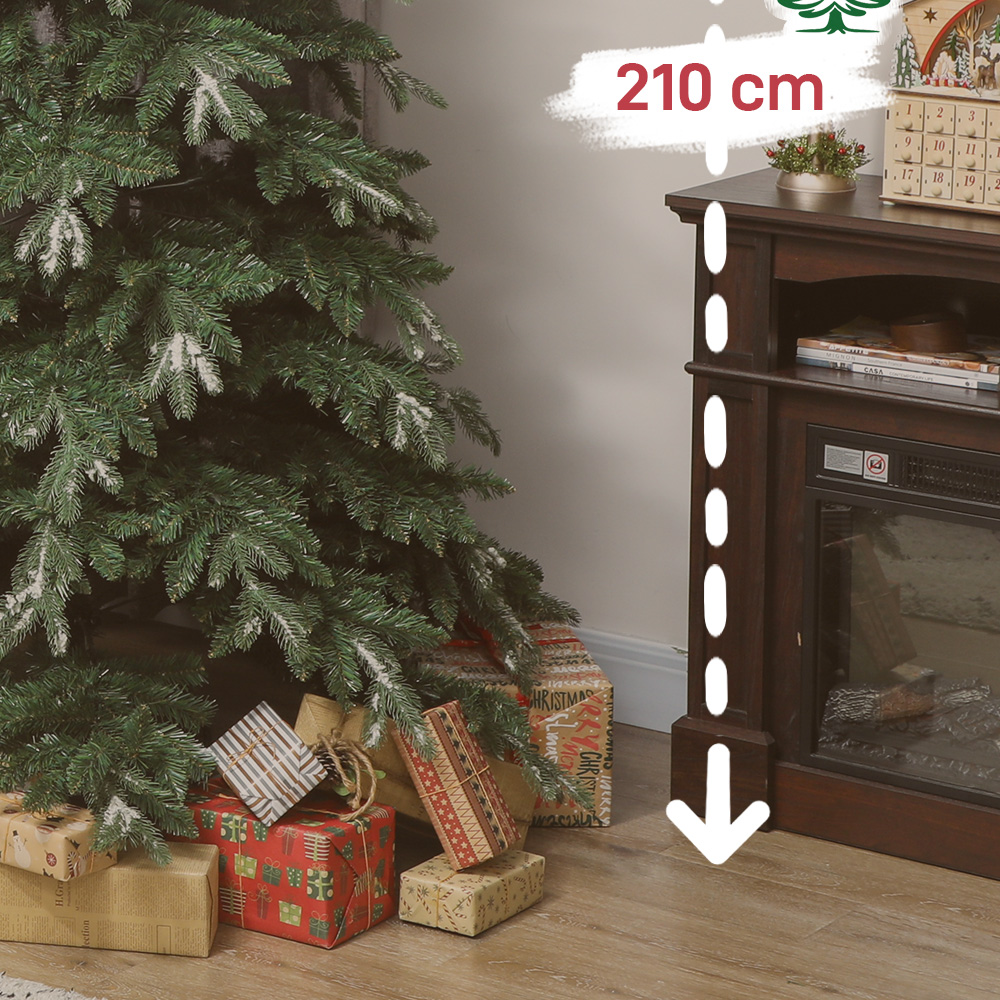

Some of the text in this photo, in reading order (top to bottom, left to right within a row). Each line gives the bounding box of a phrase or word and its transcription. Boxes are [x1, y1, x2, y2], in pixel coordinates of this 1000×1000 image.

[906, 104, 975, 122] 1 2 3
[904, 136, 912, 148] 9
[933, 140, 946, 152] 10
[965, 143, 976, 155] 11
[901, 169, 914, 180] 17
[932, 171, 944, 183] 18
[964, 175, 976, 187] 19
[825, 351, 857, 362] MIGNON
[863, 366, 884, 376] CASA
[54, 880, 65, 908] H.Gra
